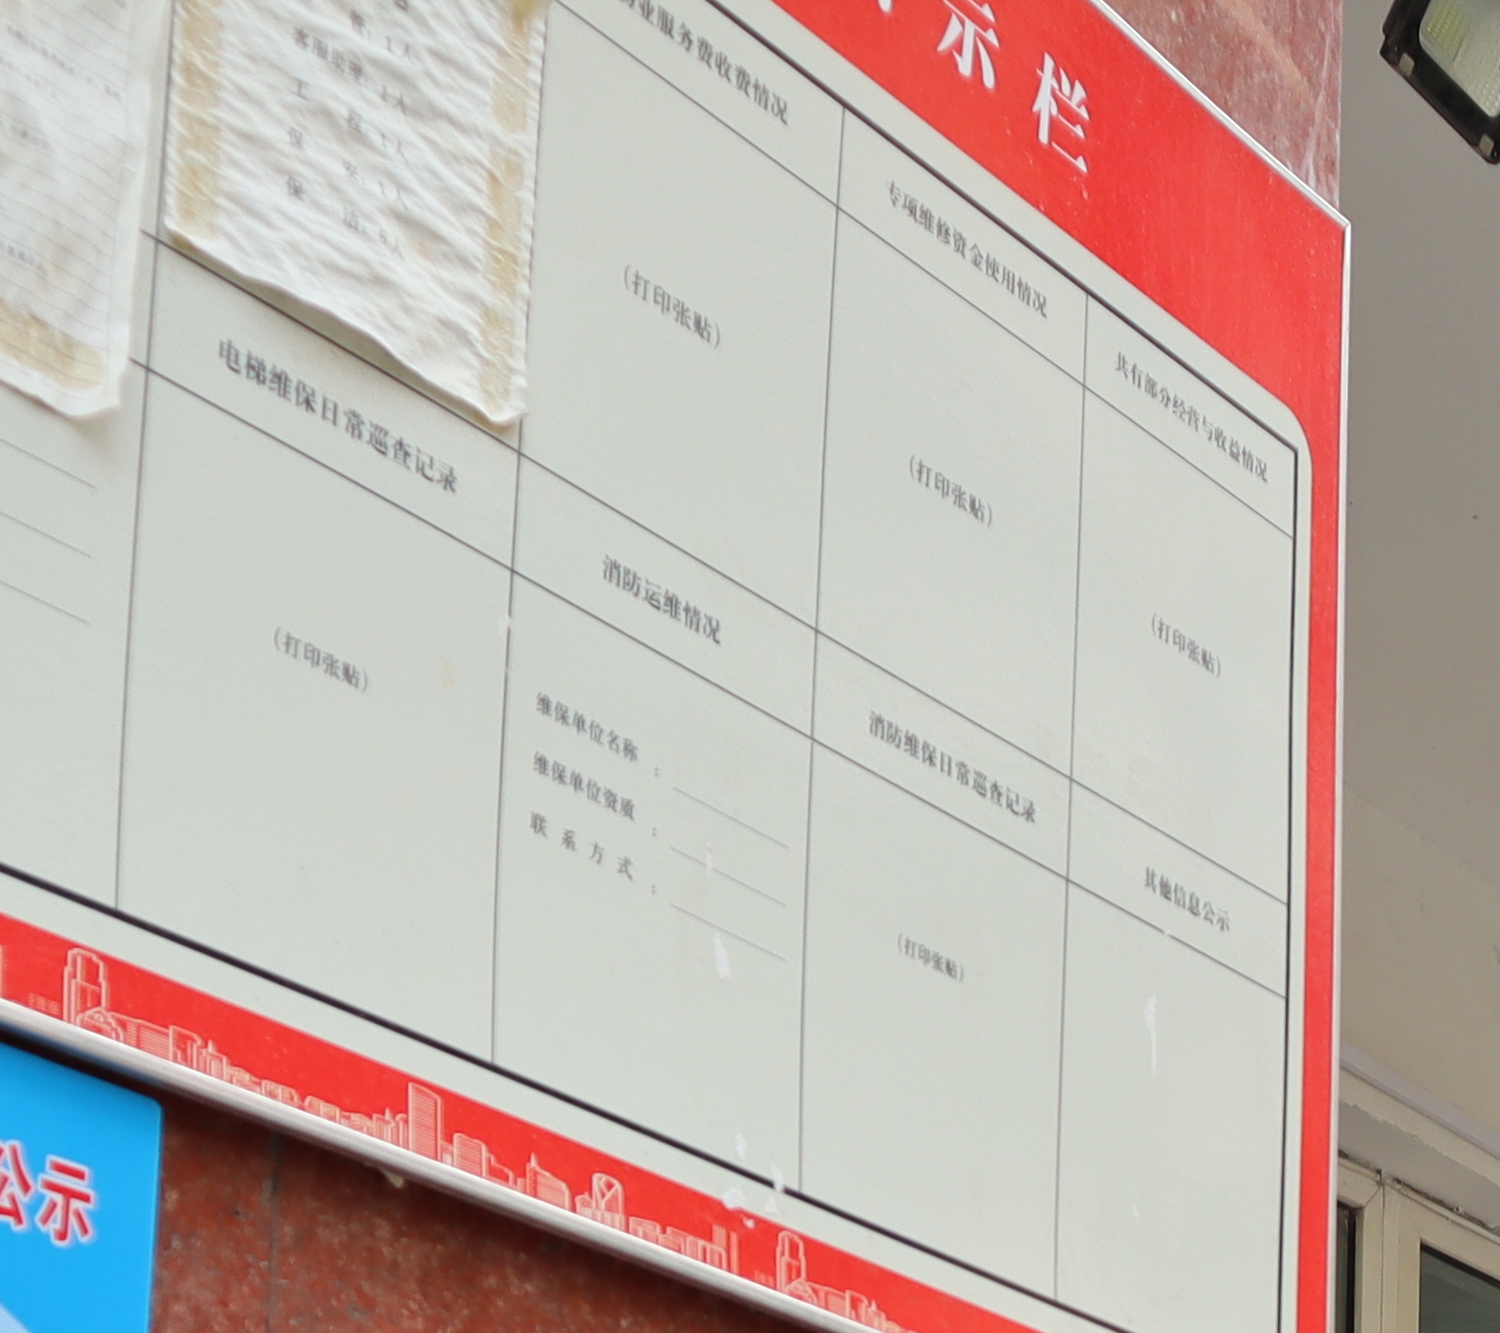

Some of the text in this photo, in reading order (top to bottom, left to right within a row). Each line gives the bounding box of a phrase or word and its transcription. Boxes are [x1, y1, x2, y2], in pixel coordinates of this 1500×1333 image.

[886, 180, 1048, 319] 专项维修资金使用情况
[623, 262, 721, 348] (打印张贴)
[217, 337, 459, 495] 电梯维保日常巡查记录
[1114, 350, 1269, 484] 共有部分经营与收益情况
[908, 452, 994, 528] (打印张贴)
[602, 554, 721, 645] 消防运维情况
[273, 625, 369, 693] (打印张贴)
[869, 709, 1038, 826] 消防维保日常巡查记录
[1143, 865, 1231, 934] 其他信息公示
